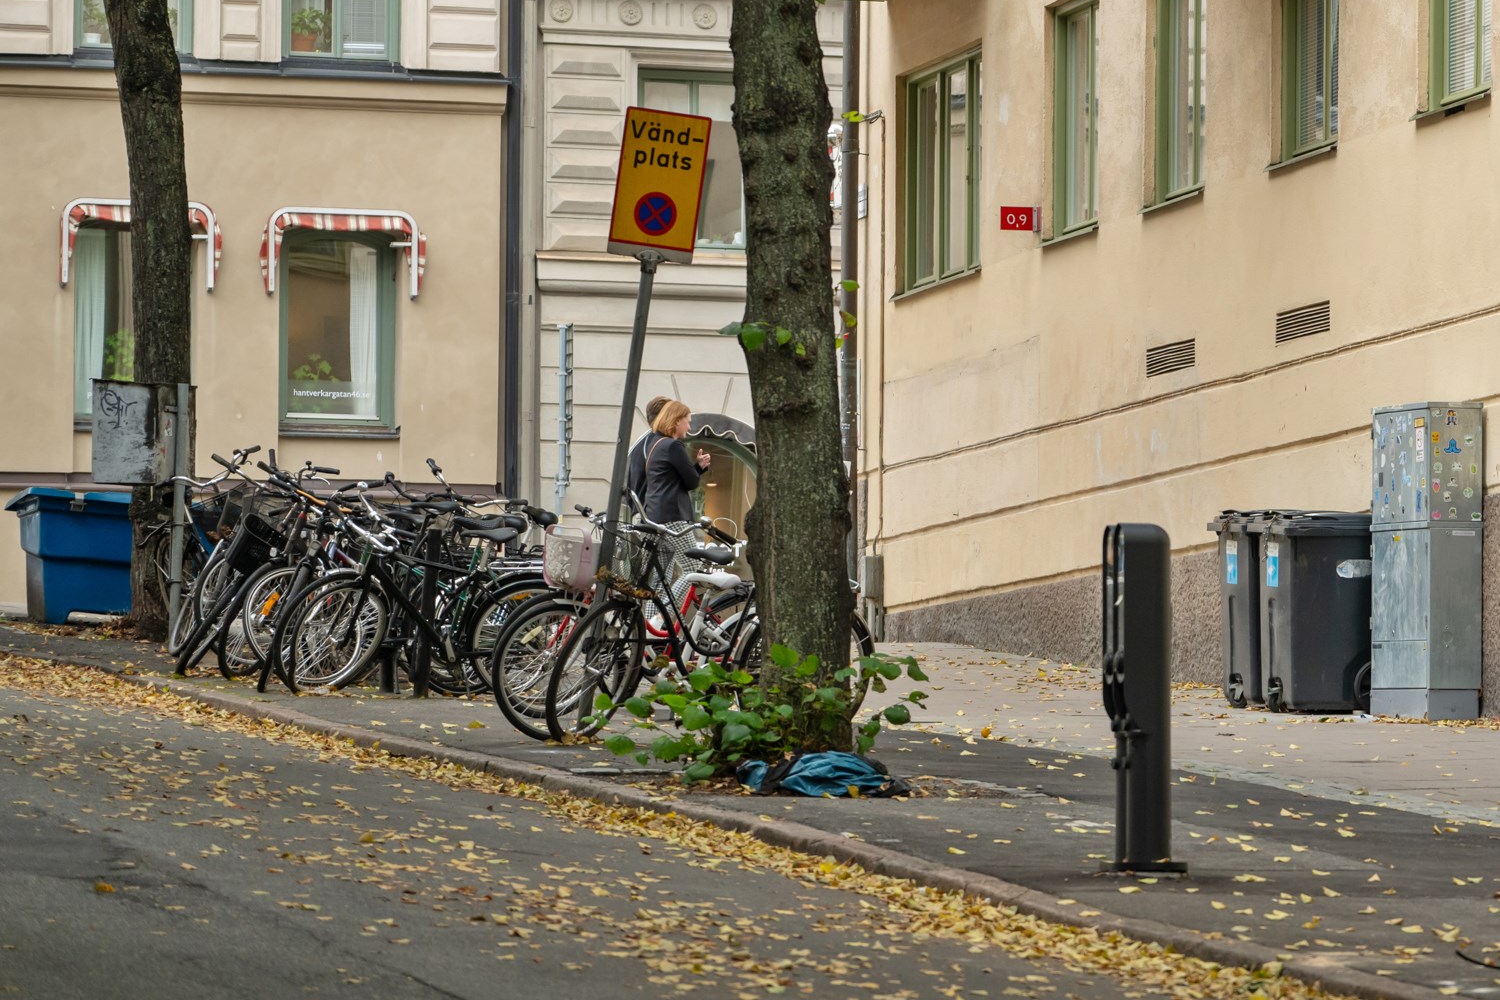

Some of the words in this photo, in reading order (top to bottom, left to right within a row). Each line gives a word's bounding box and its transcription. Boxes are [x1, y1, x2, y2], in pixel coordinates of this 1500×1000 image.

[631, 119, 704, 146] Vänd-
[633, 147, 692, 171] plats
[1006, 213, 1027, 228] 0,9
